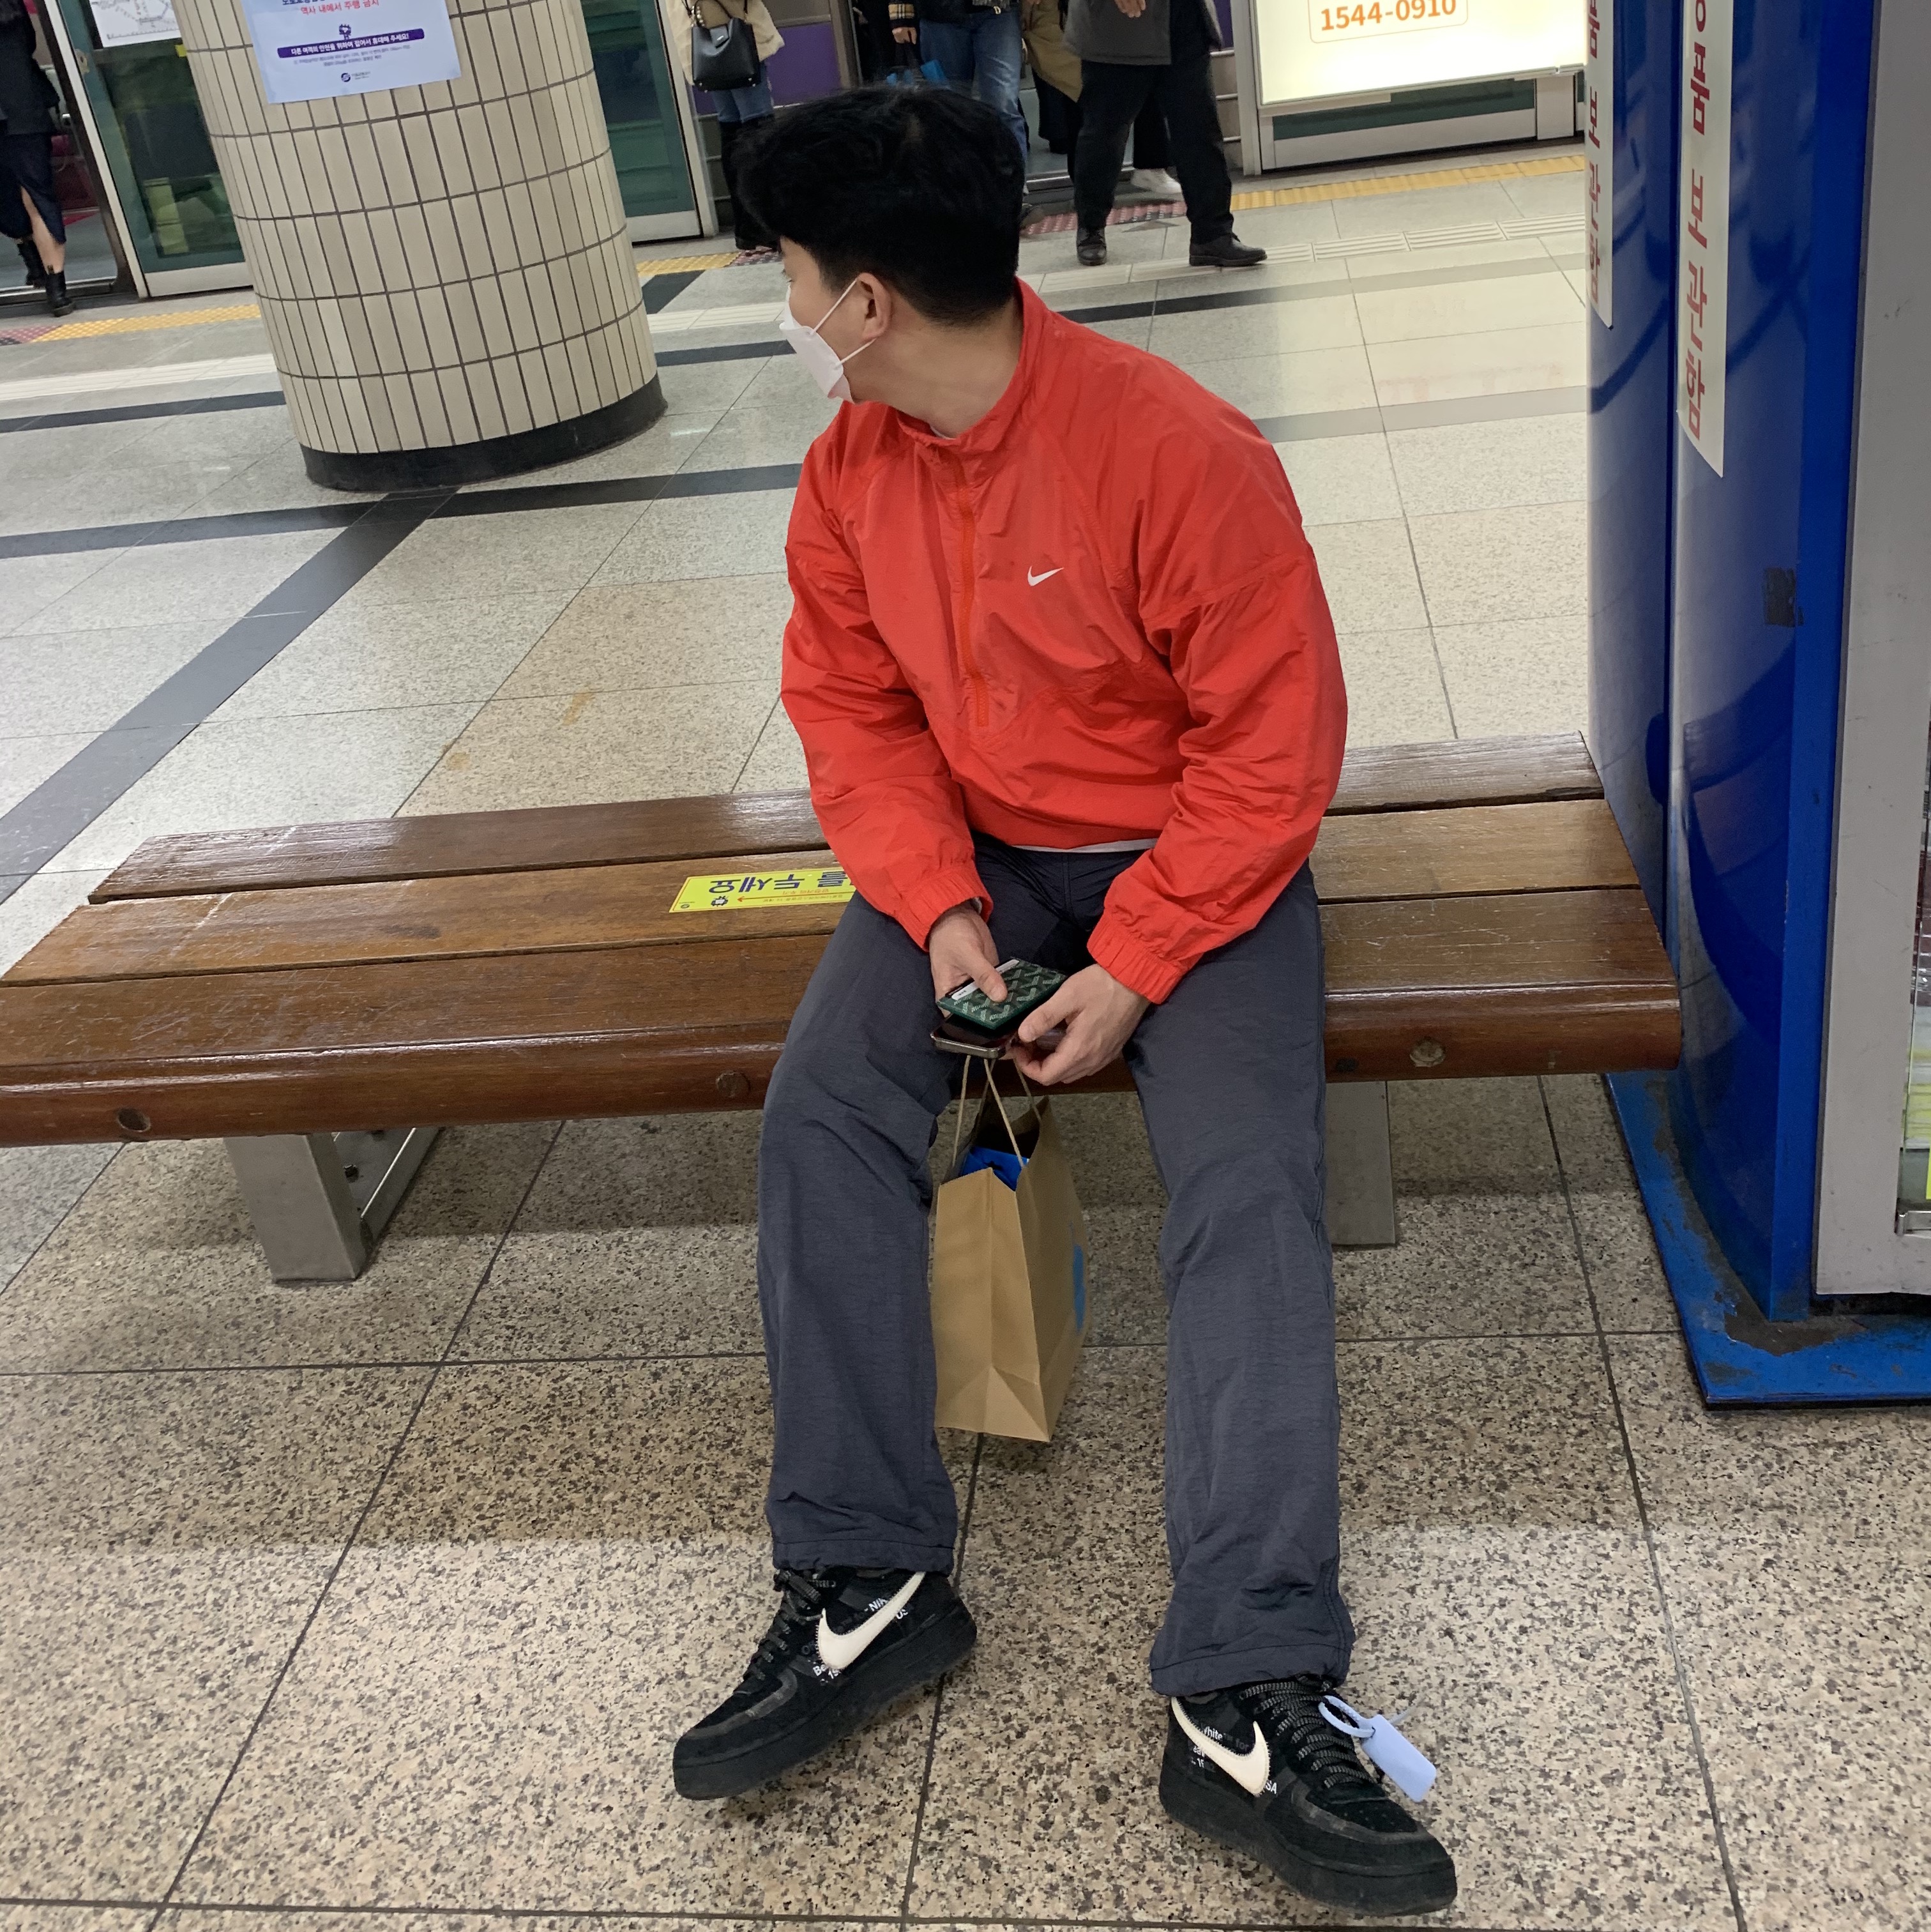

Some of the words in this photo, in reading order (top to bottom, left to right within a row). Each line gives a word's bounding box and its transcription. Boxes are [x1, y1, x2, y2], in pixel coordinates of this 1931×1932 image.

[301, 6, 316, 15] 역사
[319, 3, 342, 12] 내에서
[1321, 0, 1457, 31] 1544-0910
